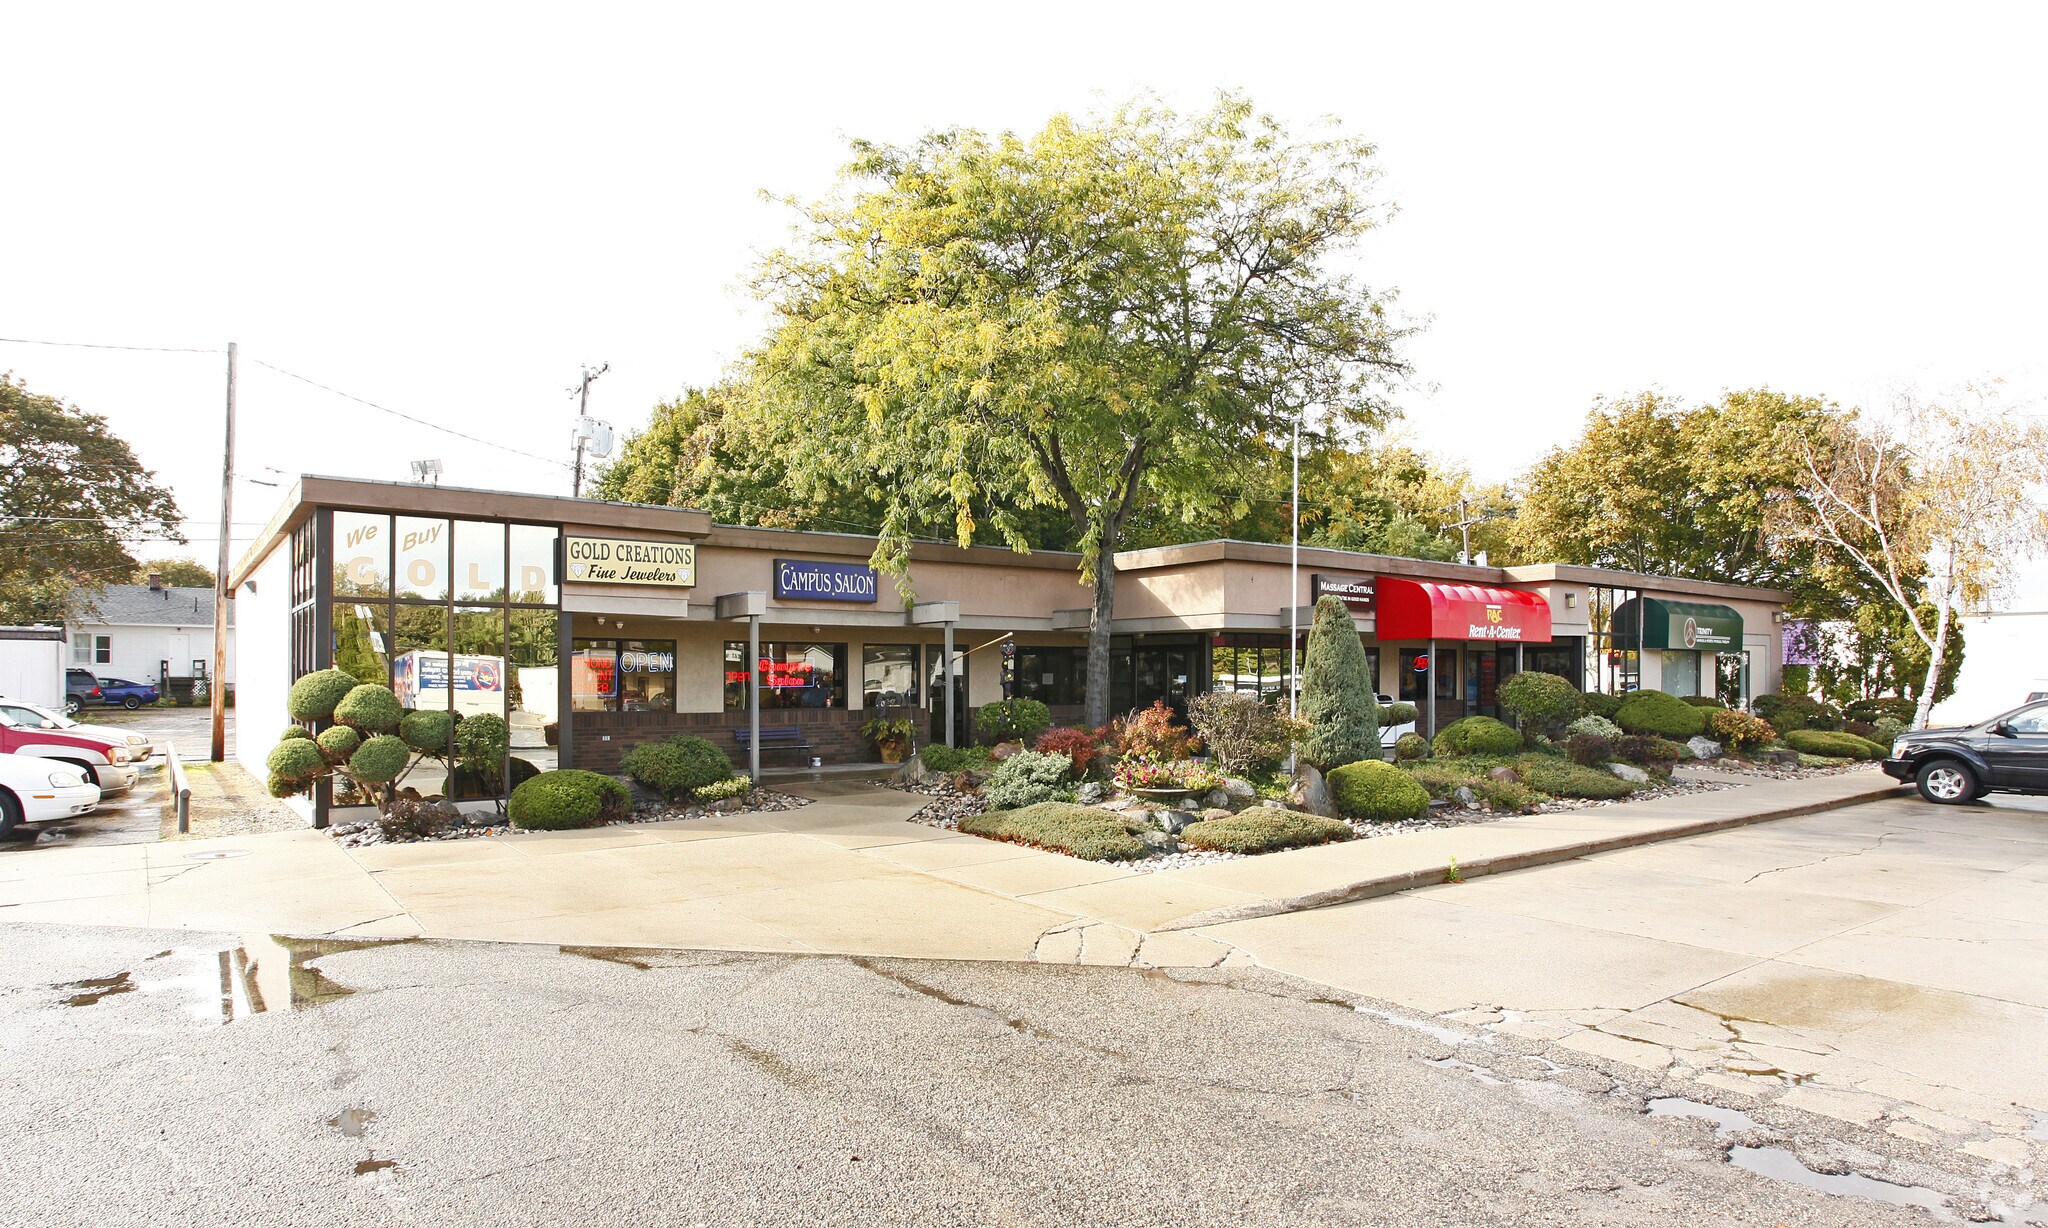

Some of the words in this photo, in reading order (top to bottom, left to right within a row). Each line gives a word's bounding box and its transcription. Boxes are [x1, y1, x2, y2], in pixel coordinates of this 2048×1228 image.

[346, 525, 378, 549] We
[402, 523, 442, 552] Buy
[570, 541, 611, 560] GOLD
[616, 544, 692, 565] CREATIONS
[347, 556, 546, 591] GOLD
[588, 564, 617, 579] Fine
[620, 566, 676, 582] Jewelers
[781, 569, 831, 592] CAMPUS
[835, 572, 874, 594] SALON
[1320, 582, 1348, 592] MASSAGE
[1348, 584, 1374, 594] CENTRAL
[1486, 609, 1503, 623] RAC
[620, 652, 673, 672] OPEN
